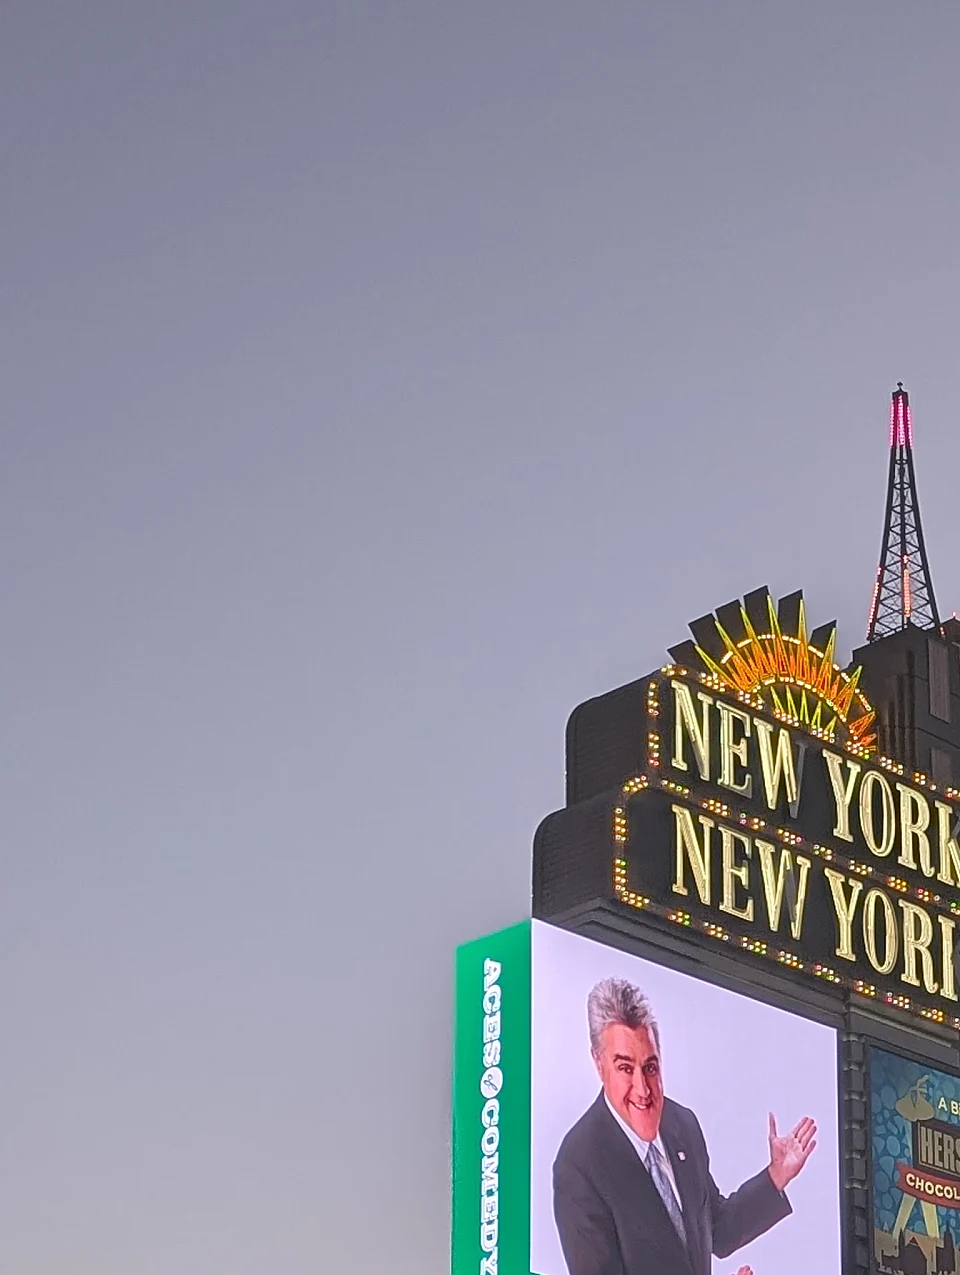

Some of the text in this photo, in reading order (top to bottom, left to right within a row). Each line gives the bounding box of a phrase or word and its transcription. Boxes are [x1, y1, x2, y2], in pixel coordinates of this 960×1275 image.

[671, 679, 805, 819] NEW
[671, 804, 811, 941] NEW
[482, 957, 502, 1068] ACES
[937, 1097, 948, 1112] A
